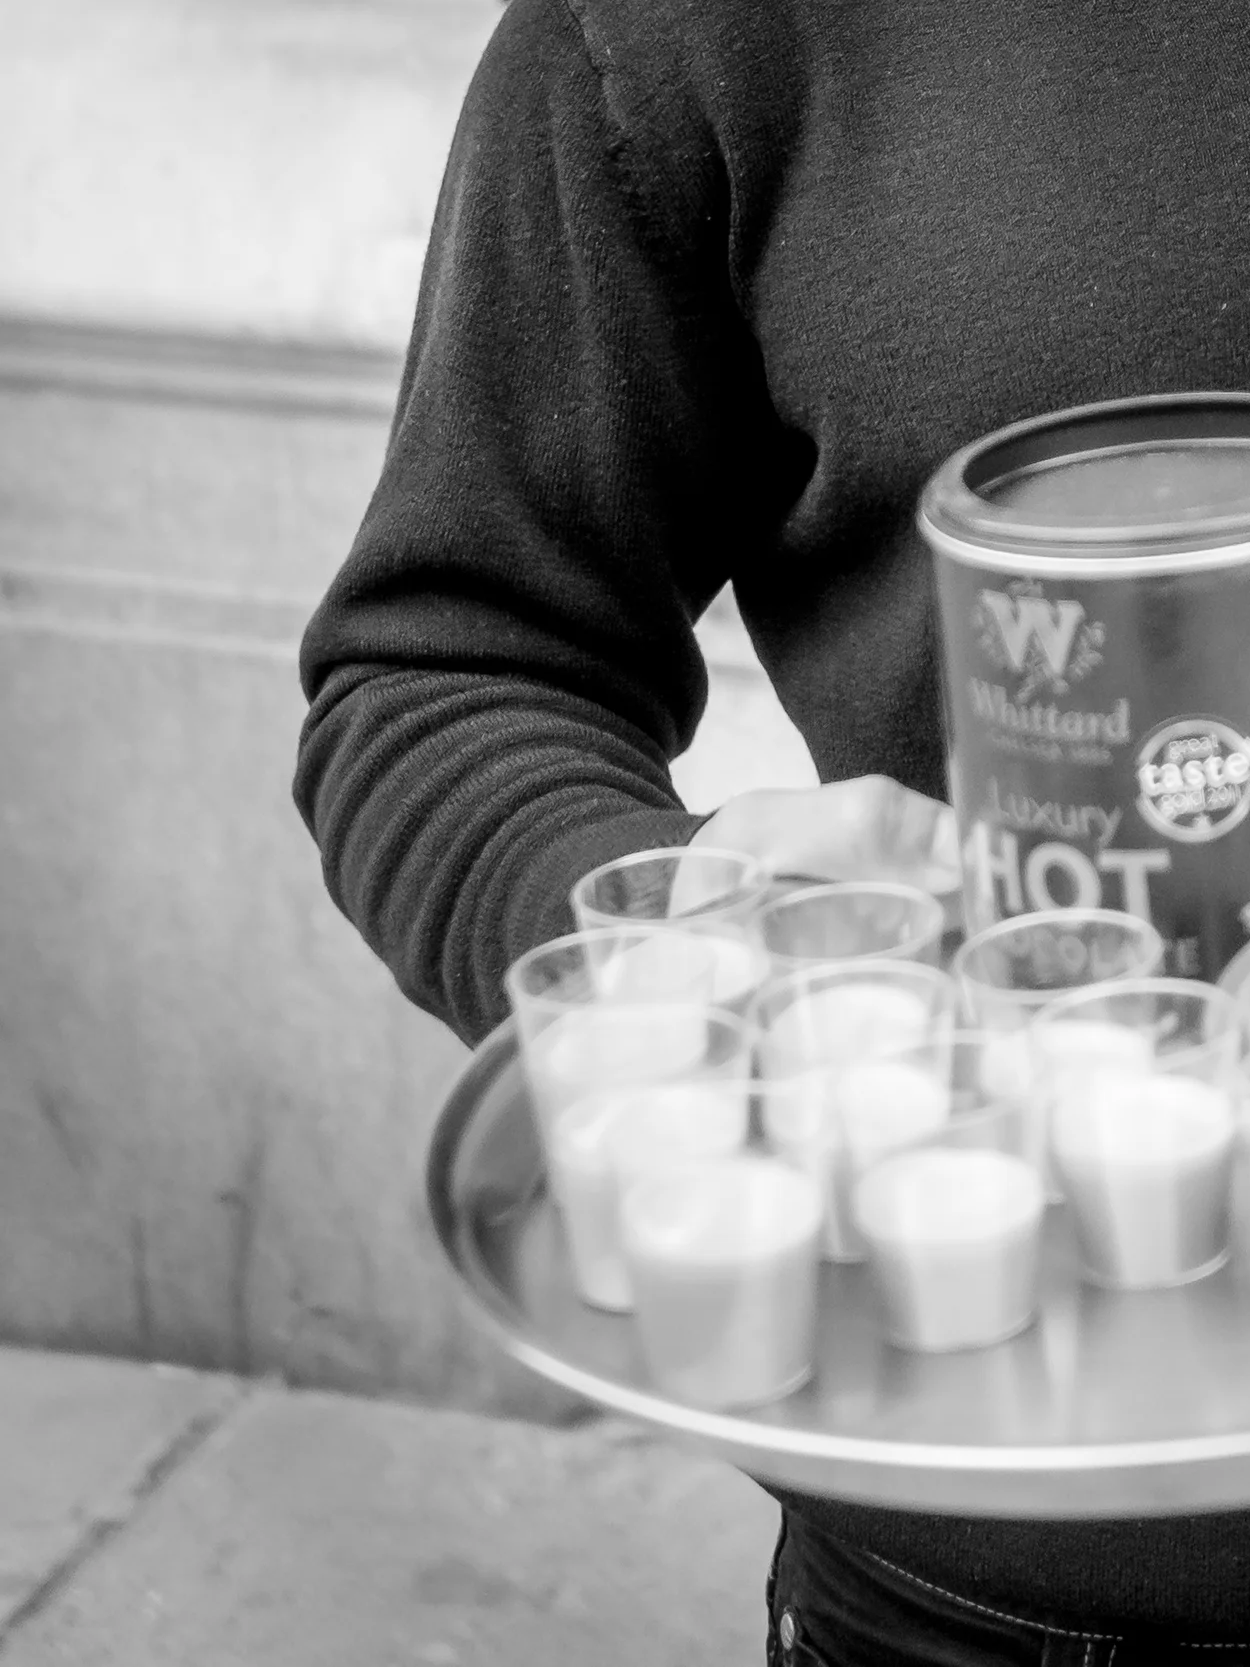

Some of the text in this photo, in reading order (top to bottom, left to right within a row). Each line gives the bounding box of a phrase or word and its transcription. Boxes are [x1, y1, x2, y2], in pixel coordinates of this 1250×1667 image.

[971, 676, 1130, 745] Whittard
[1167, 735, 1217, 765] great
[991, 776, 1123, 847] Luxury
[1161, 788, 1206, 819] gold
[972, 822, 1171, 926] HOT
